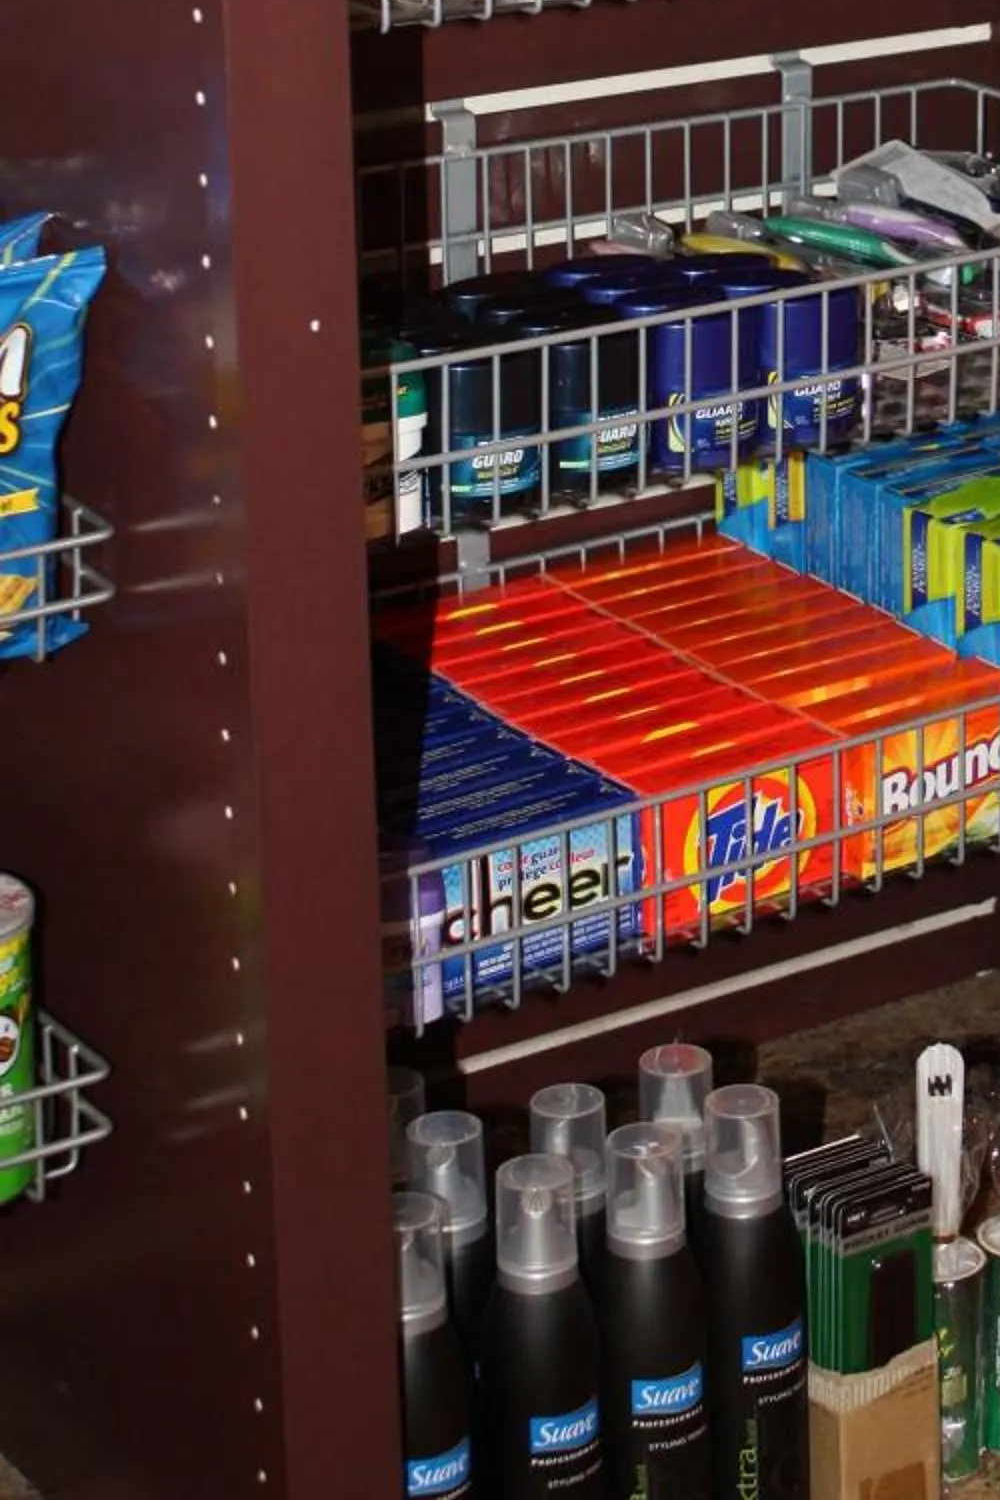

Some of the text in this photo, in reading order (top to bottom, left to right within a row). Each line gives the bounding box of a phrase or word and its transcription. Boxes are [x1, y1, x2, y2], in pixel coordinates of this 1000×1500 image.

[700, 792, 804, 908] Tide
[443, 850, 634, 946] cheer
[744, 1332, 801, 1366] Suave
[635, 1379, 699, 1409] Suave
[533, 1410, 597, 1448] Suave
[407, 1453, 470, 1492] Suave
[735, 1448, 758, 1500] xtra
